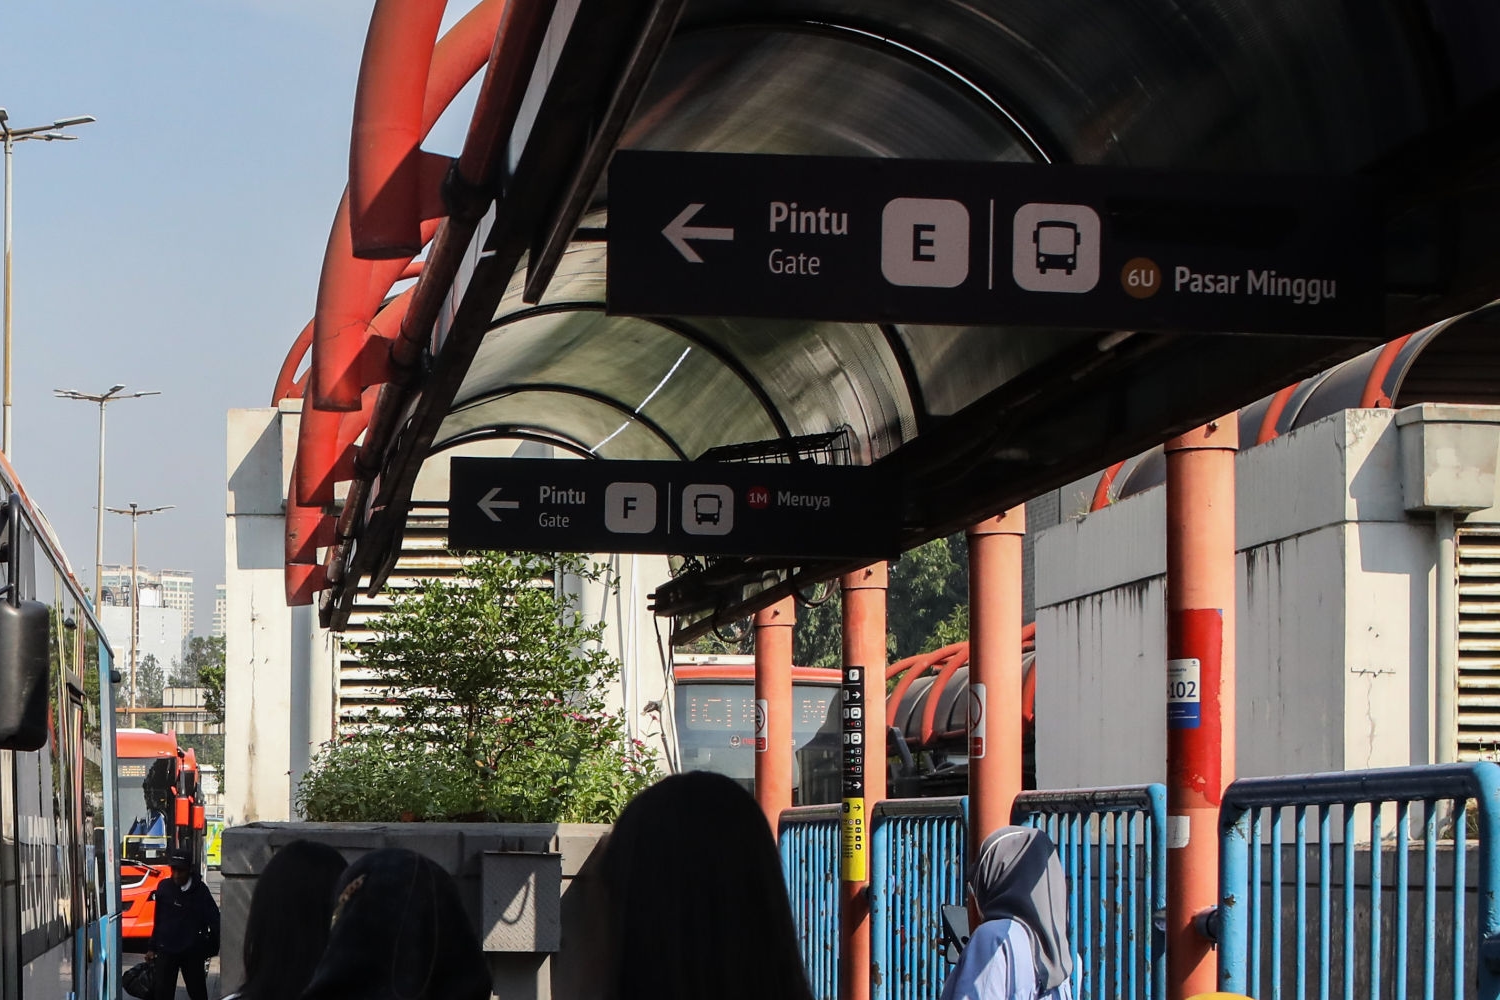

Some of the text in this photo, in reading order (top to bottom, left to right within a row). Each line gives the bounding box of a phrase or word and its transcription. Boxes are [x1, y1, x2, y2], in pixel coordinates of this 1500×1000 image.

[769, 202, 936, 263] Pintu E
[768, 248, 821, 276] Gate
[1127, 265, 1337, 304] 6U Pasar Minggu
[538, 511, 570, 529] Gate
[539, 485, 831, 520] Pintu F 1M Meruya
